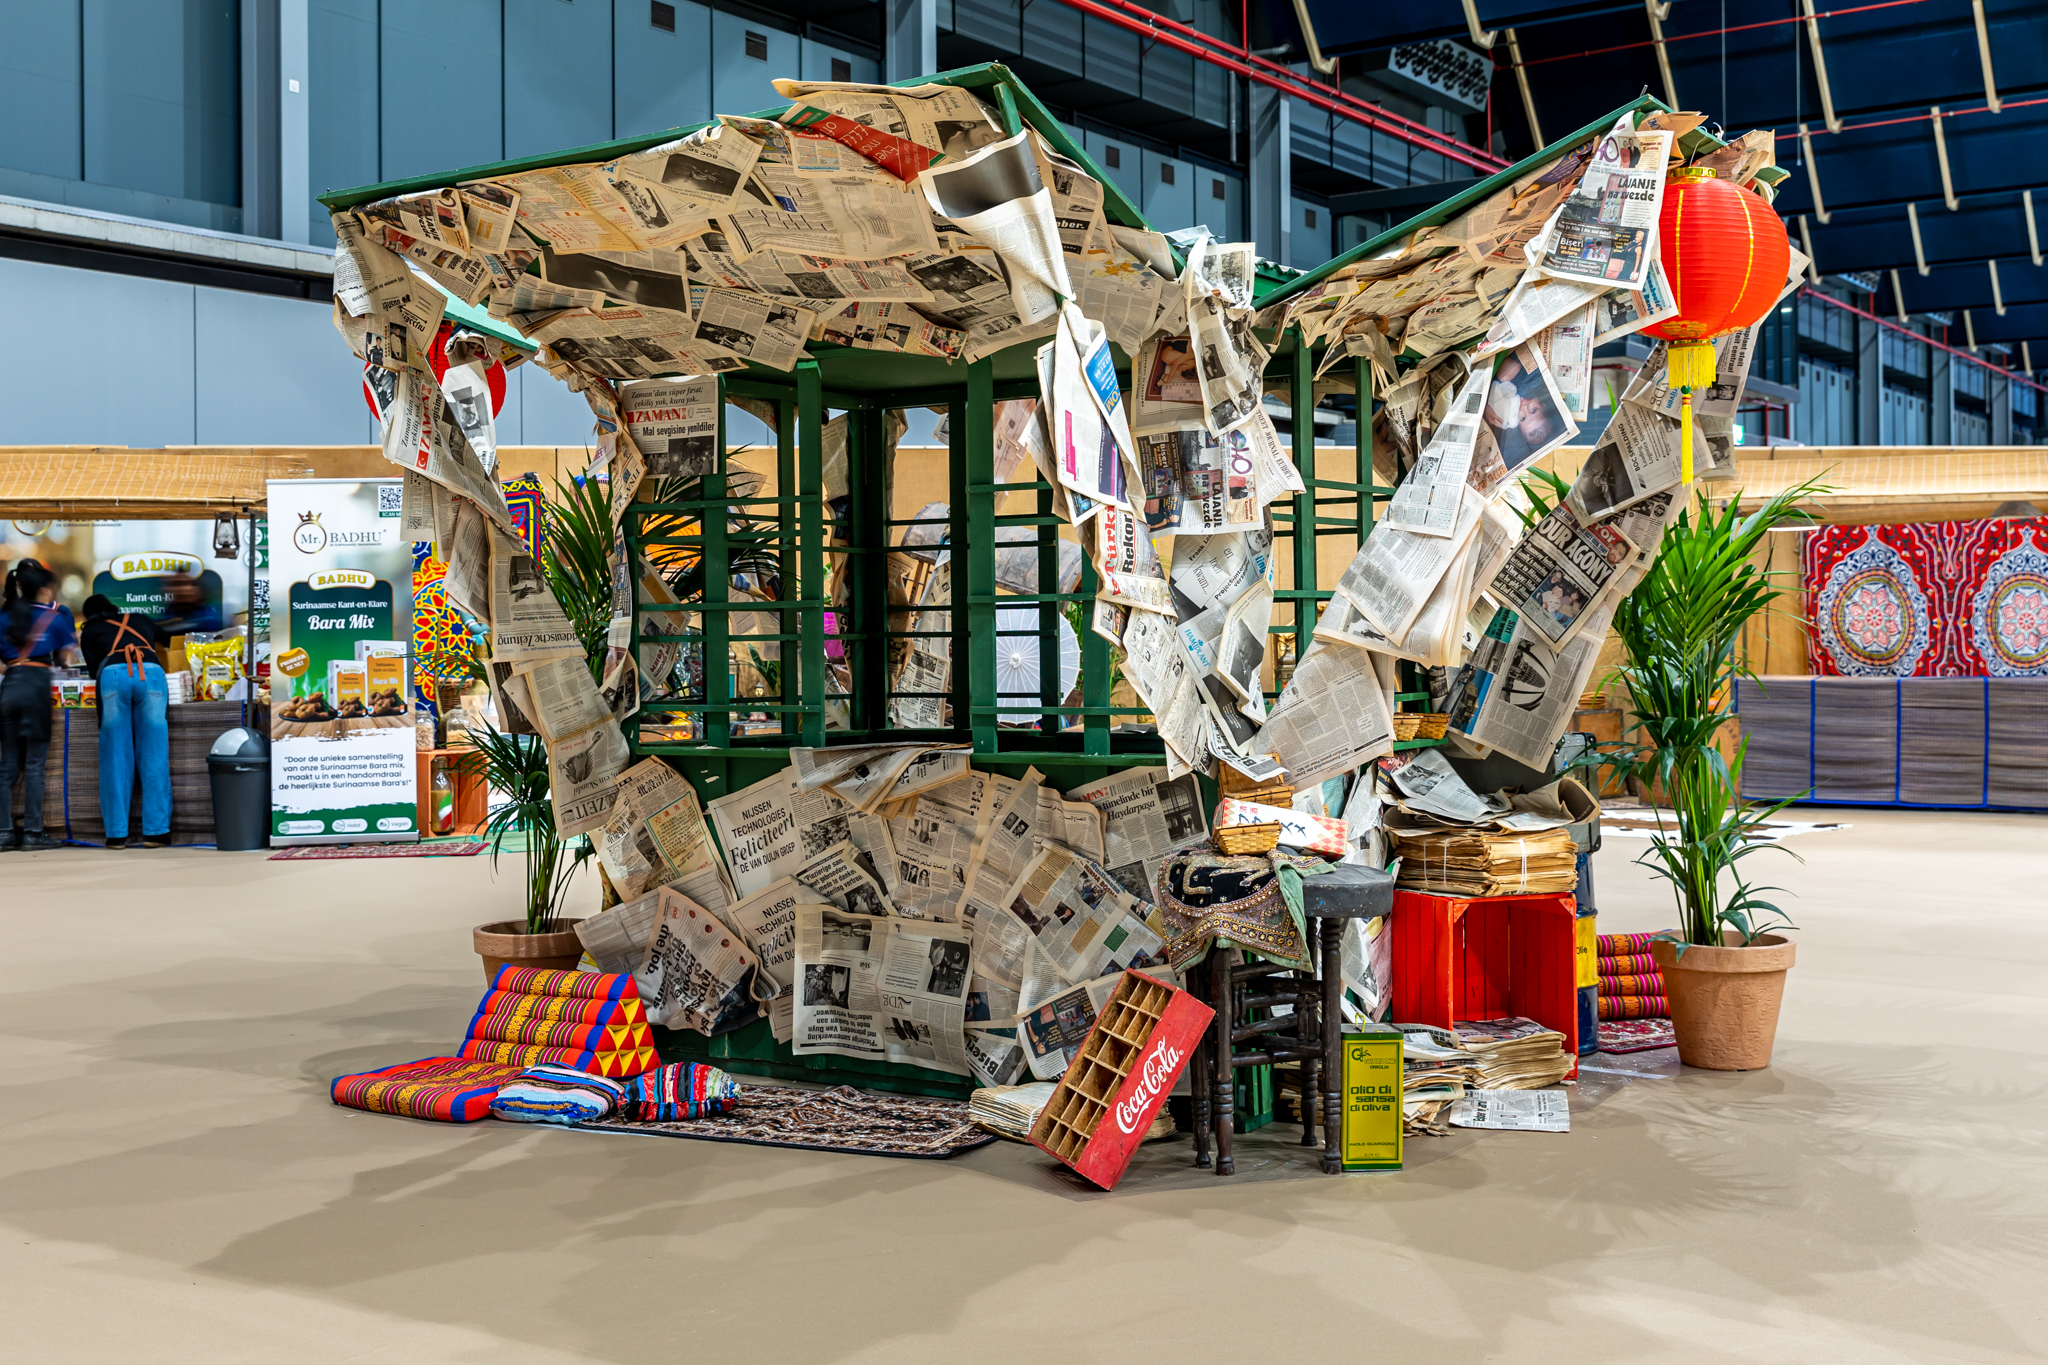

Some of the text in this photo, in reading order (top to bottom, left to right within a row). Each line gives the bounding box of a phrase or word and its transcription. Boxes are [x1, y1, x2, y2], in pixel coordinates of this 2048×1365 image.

[1618, 178, 1656, 189] LAJANJE
[1608, 190, 1654, 201] na zvezde
[1728, 344, 1738, 373] centraal
[636, 408, 680, 423] ZAMAN
[643, 422, 715, 437] Mal sevgisine yenildiler
[1265, 431, 1294, 480] JOURNAL EUROPE
[1618, 423, 1640, 472] BOC SPALDING
[1202, 491, 1212, 528] zvezde
[1212, 482, 1222, 527] LAJANJE
[300, 532, 381, 544] Mr. BADHU
[1122, 515, 1135, 574] Rekor
[1189, 544, 1205, 561] Frank
[1224, 548, 1234, 559] en
[1538, 517, 1572, 551] OUR
[1564, 541, 1613, 584] AGONY
[123, 556, 192, 573] BADHU
[1209, 556, 1222, 574] toen
[318, 574, 367, 585] BADHU
[1527, 568, 1543, 584] Mirror
[1500, 584, 1511, 594] Dad
[1508, 590, 1525, 606] forever
[308, 614, 375, 630] Bara Mix
[497, 633, 578, 647] Zeitung ddeutsche
[348, 753, 403, 762] samenstelling
[390, 761, 405, 770] mix,
[291, 781, 331, 790] heerlijkste
[573, 780, 598, 796] Skandal
[1102, 786, 1154, 810] tünelinde bir
[575, 796, 606, 819] ZEIT
[742, 800, 772, 820] NIJSSEN
[1107, 800, 1155, 821] Haydarpaşa
[732, 808, 786, 838] TECHNOLOGIES
[730, 813, 795, 866] Feliciteert
[740, 841, 796, 873] DE VAN DUIJN GROEP
[804, 865, 831, 881] "Plezierige
[819, 865, 848, 884] gebroeders
[818, 883, 832, 893] mede
[762, 896, 796, 918] NIJSSEN
[645, 924, 670, 976] the job.
[769, 953, 785, 968] VAN
[848, 1012, 872, 1021] onderling
[808, 1033, 850, 1041] samenwerking
[840, 1026, 866, 1036] gebroeders
[1116, 1036, 1180, 1134] Coca-Cola
[1351, 1085, 1391, 1094] olio di
